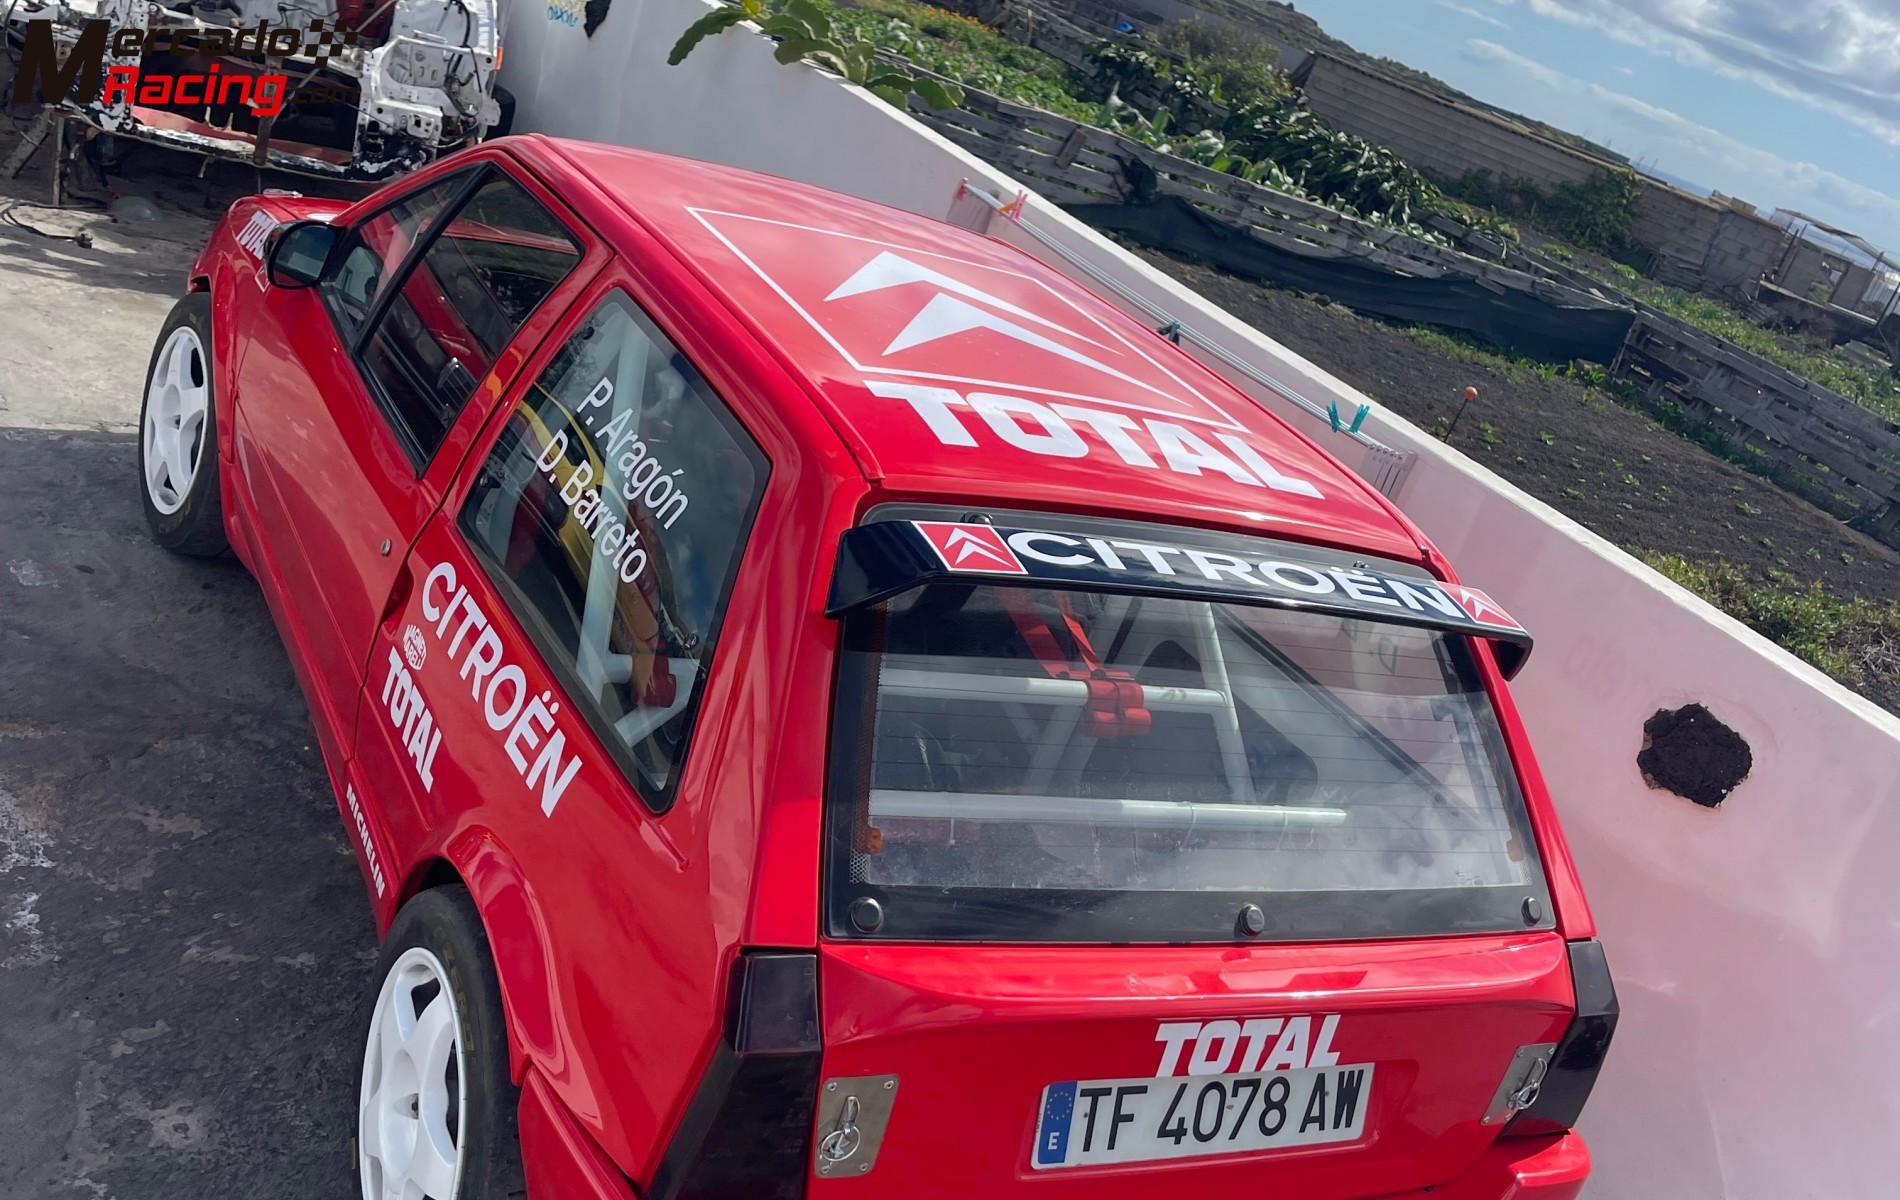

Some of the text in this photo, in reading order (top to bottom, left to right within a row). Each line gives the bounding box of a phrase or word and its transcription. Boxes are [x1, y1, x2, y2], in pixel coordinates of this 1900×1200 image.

[576, 376, 690, 530] P. Aragón
[863, 380, 1325, 499] TOTAL
[536, 428, 648, 584] D. Barreto
[1009, 531, 1463, 618] CITROËN
[382, 645, 442, 793] TOTAL
[422, 562, 583, 818] CITROËN
[346, 782, 386, 899] MICHELIN
[1154, 1013, 1341, 1078] TOTAL
[1047, 1131, 1060, 1150] E
[1080, 1068, 1365, 1153] TF 4078 AW
